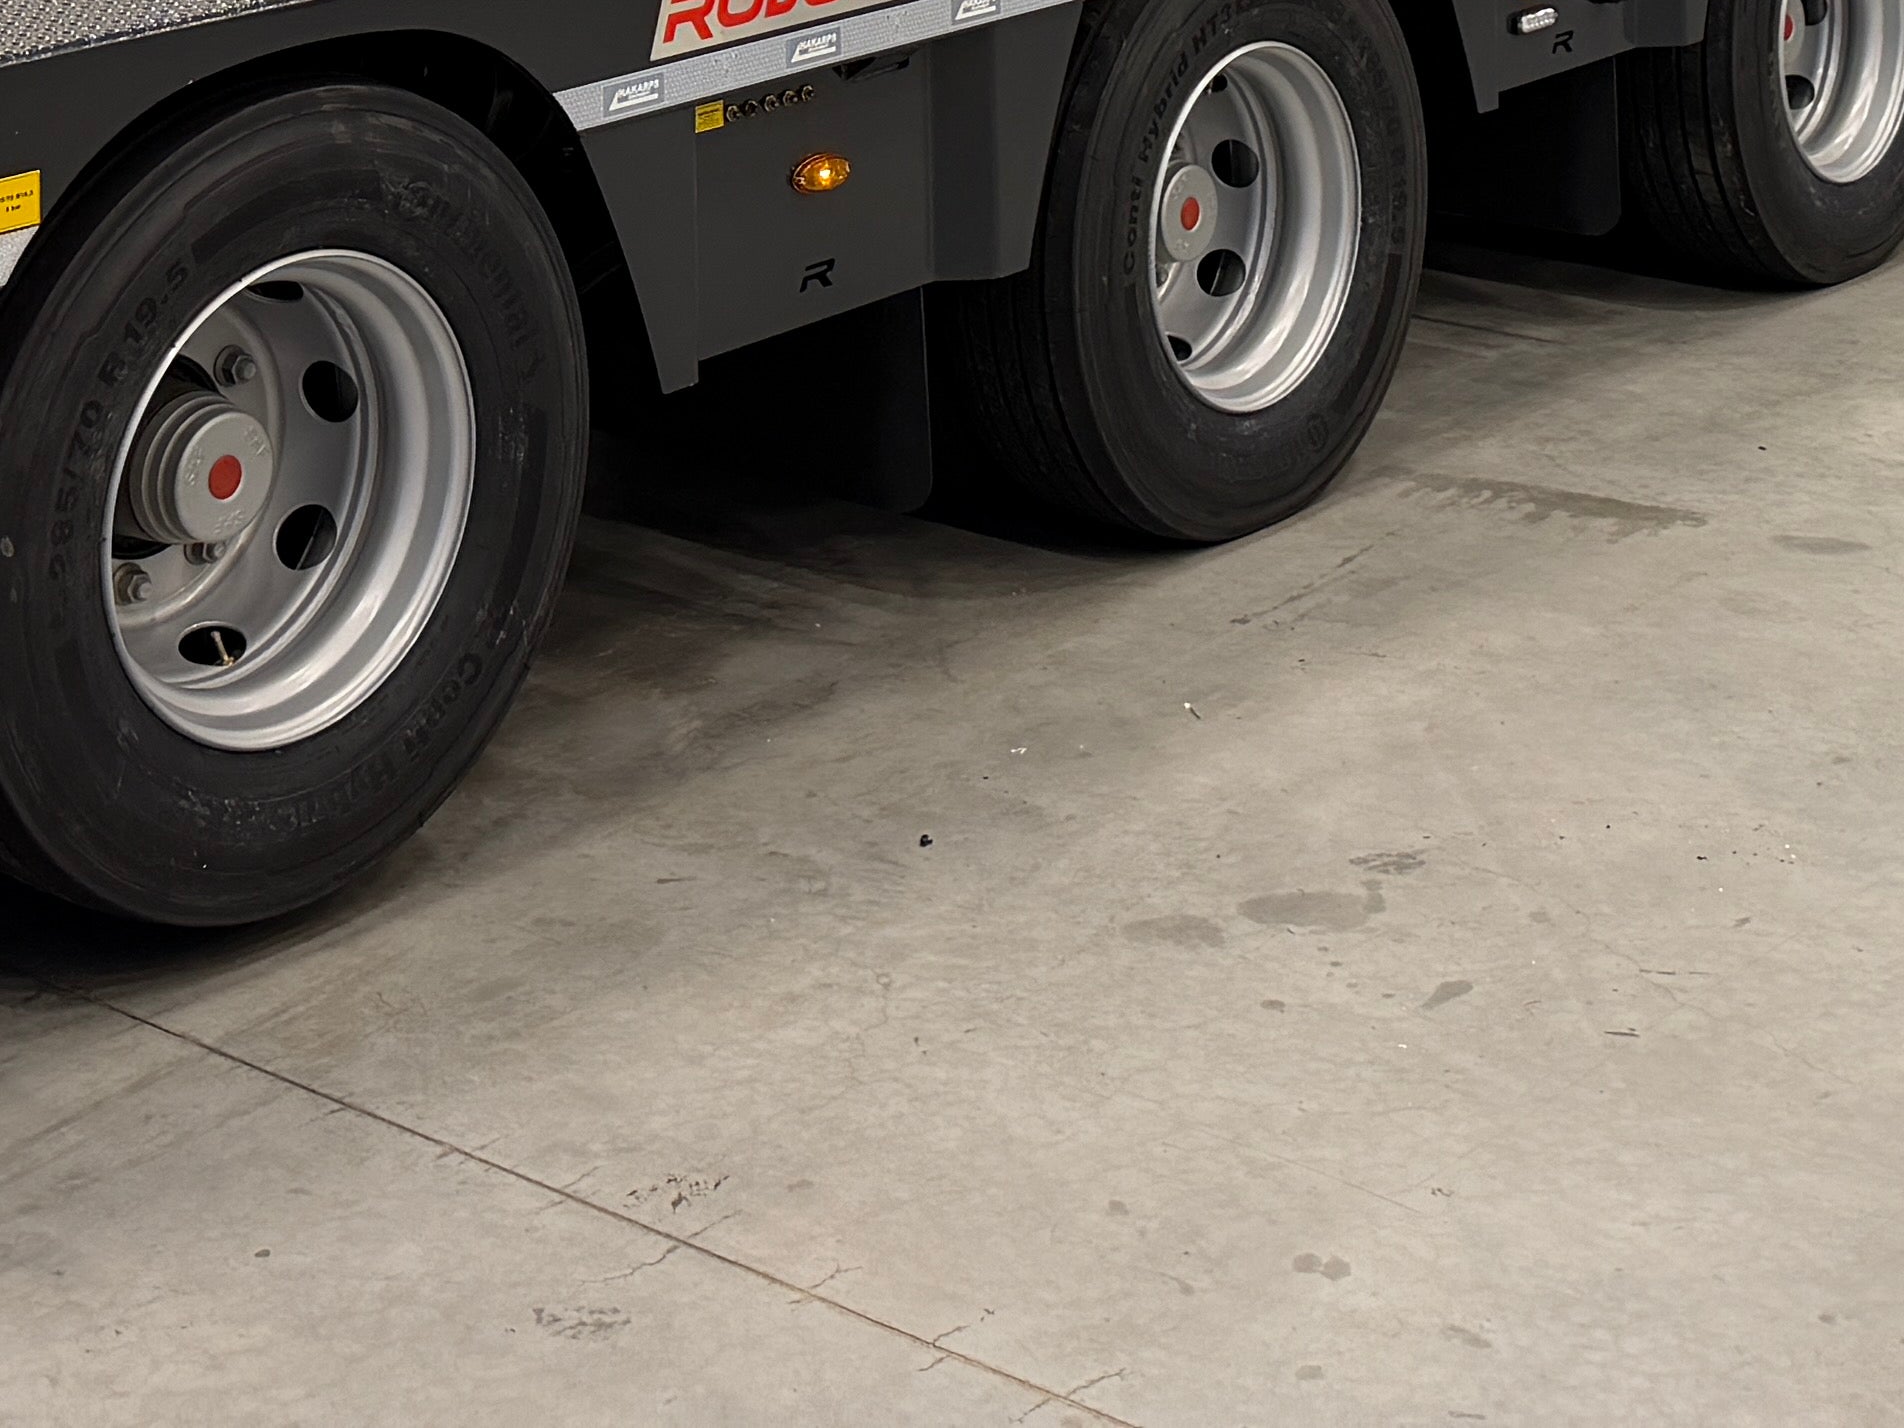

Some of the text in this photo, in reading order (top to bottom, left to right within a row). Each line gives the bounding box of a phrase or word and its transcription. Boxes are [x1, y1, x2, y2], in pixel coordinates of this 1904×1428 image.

[1123, 176, 1144, 276] Conti
[1138, 50, 1189, 163] Hybrid
[48, 398, 104, 582] 285/70
[124, 257, 191, 344] 19.5
